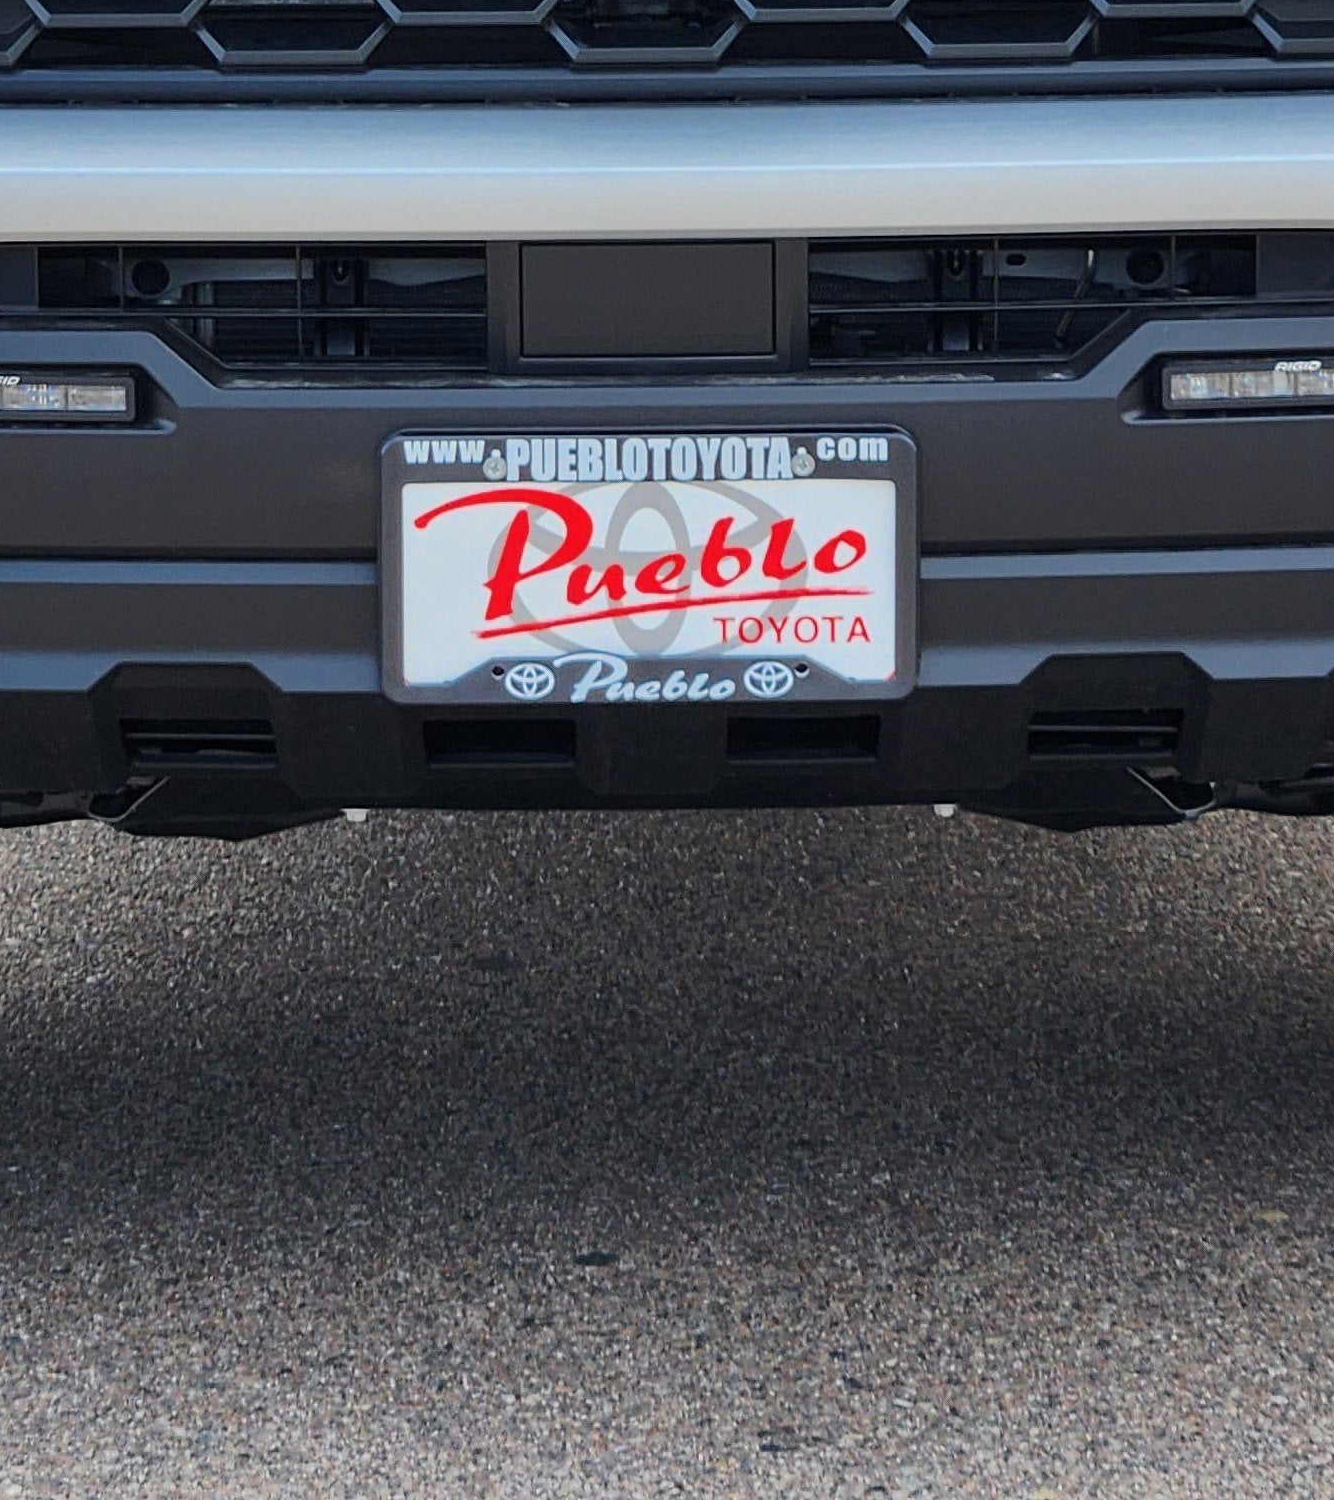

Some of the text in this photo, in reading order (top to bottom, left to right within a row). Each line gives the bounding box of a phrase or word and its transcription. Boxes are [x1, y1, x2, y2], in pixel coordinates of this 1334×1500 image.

[1274, 360, 1322, 372] RIGID
[413, 487, 868, 621] Pueblo
[713, 615, 871, 645] TOYOTA
[553, 651, 736, 703] Pueblo
